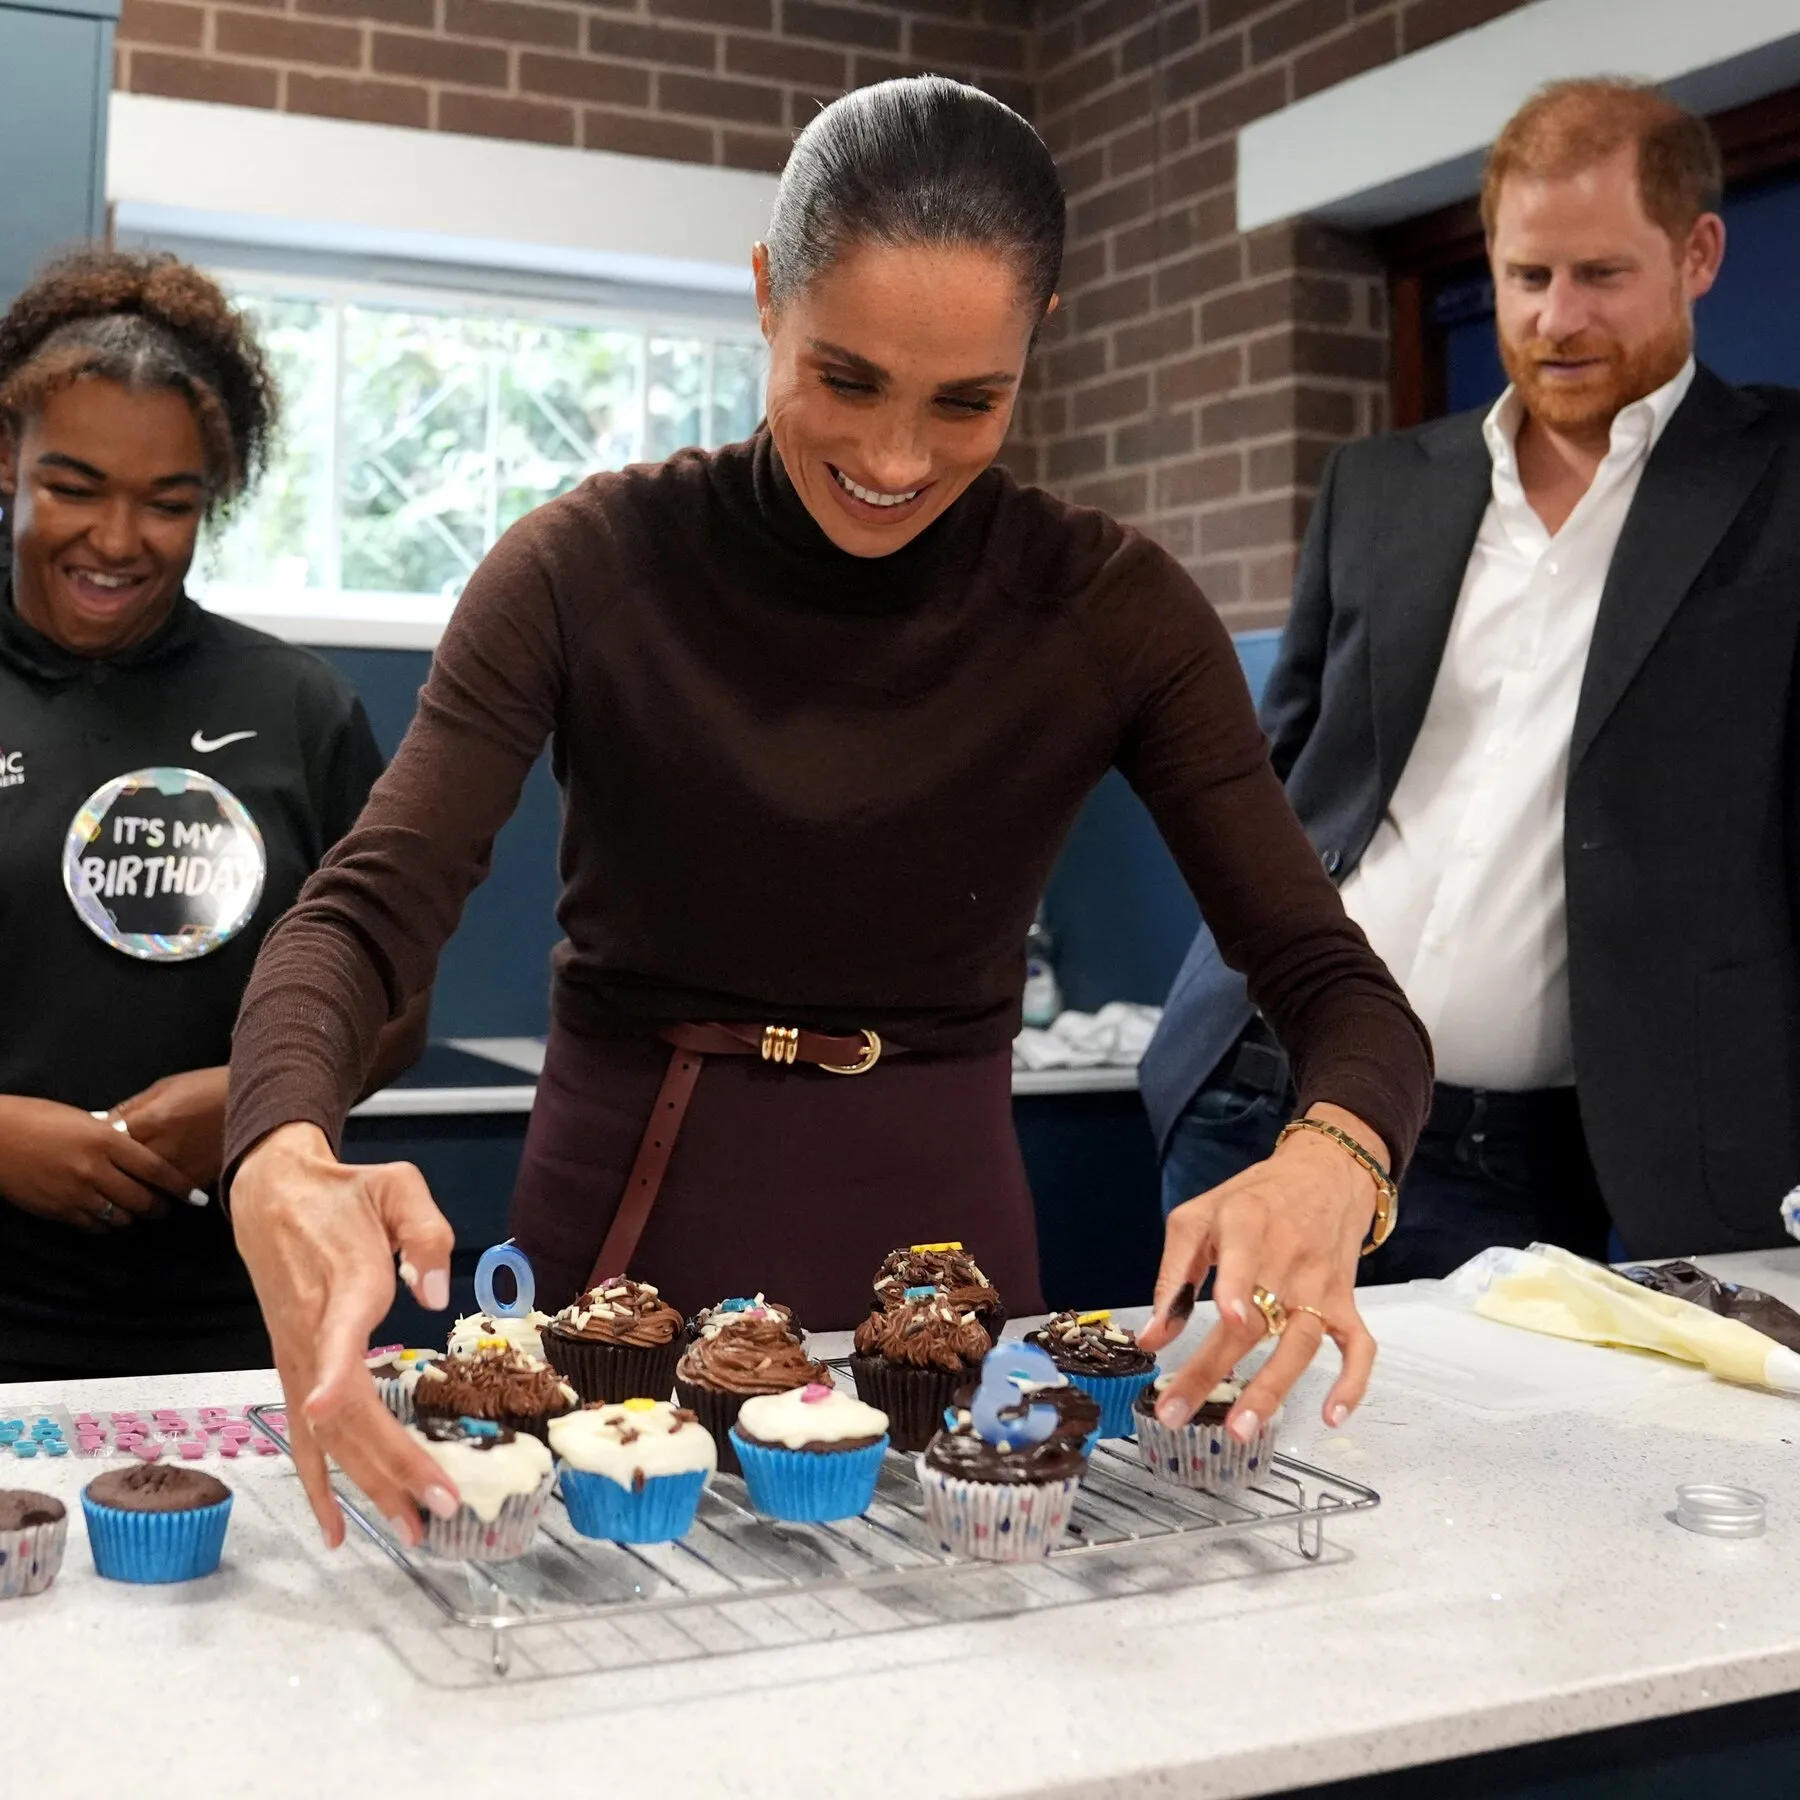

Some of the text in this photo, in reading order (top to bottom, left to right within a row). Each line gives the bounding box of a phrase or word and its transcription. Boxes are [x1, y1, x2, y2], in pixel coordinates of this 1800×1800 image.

[113, 816, 223, 850] IT'S MY
[79, 854, 254, 899] BIRTHDAY
